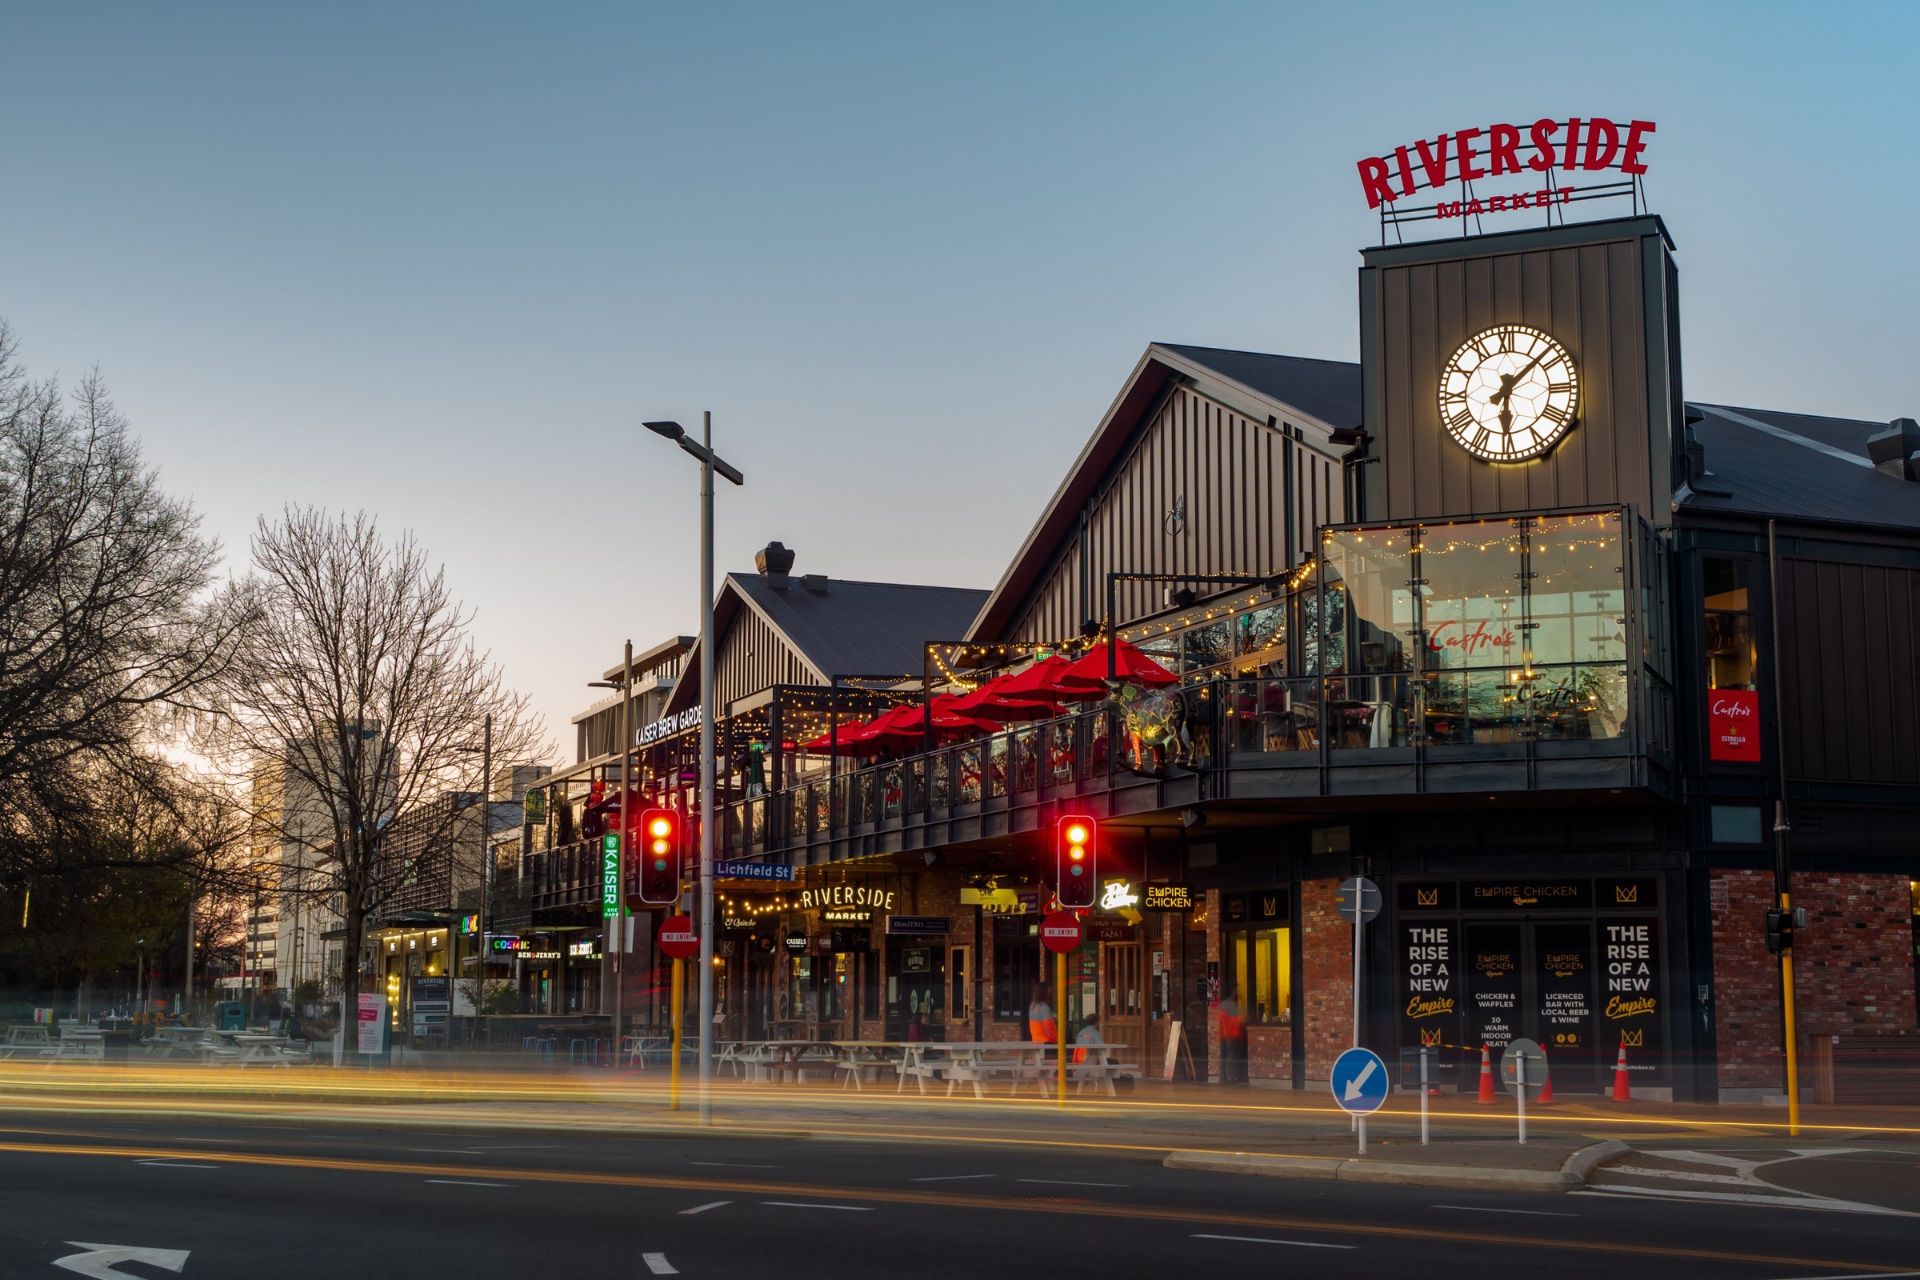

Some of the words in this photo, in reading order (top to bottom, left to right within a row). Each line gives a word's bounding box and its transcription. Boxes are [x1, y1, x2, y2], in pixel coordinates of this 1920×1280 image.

[1357, 118, 1656, 209] RIVERSIDE
[1437, 187, 1575, 219] MARKET
[1428, 620, 1515, 655] Castro's
[1713, 700, 1751, 719] Castro's
[636, 722, 658, 746] KAISER
[658, 713, 678, 738] BREW
[680, 705, 702, 730] GARDE
[1721, 735, 1746, 743] ESTRELLA
[604, 849, 618, 904] KAISER
[717, 862, 772, 877] Lichfield
[775, 866, 789, 878] St
[802, 886, 895, 910] RIVERSIDE
[1148, 886, 1188, 897] EMPIRE
[1474, 886, 1520, 897] EMPIRE
[1523, 886, 1577, 896] CHICKEN
[1145, 897, 1192, 908] CHICKEN
[825, 911, 871, 920] MARKET
[1408, 928, 1449, 943] THE
[1606, 926, 1649, 941] THE
[494, 940, 530, 950] COSMIC
[1607, 945, 1650, 959] RISE
[1409, 946, 1449, 960] RISE
[1478, 954, 1511, 962] EMPIRE
[1547, 954, 1580, 962] EMPIRE
[1410, 963, 1432, 975] OF
[1437, 963, 1449, 975] A
[1608, 962, 1632, 975] OF
[1637, 962, 1650, 975] A
[1410, 979, 1449, 991] NEW
[1609, 978, 1650, 991] NEW
[1406, 995, 1455, 1016] Empire
[1605, 995, 1656, 1016] Empire
